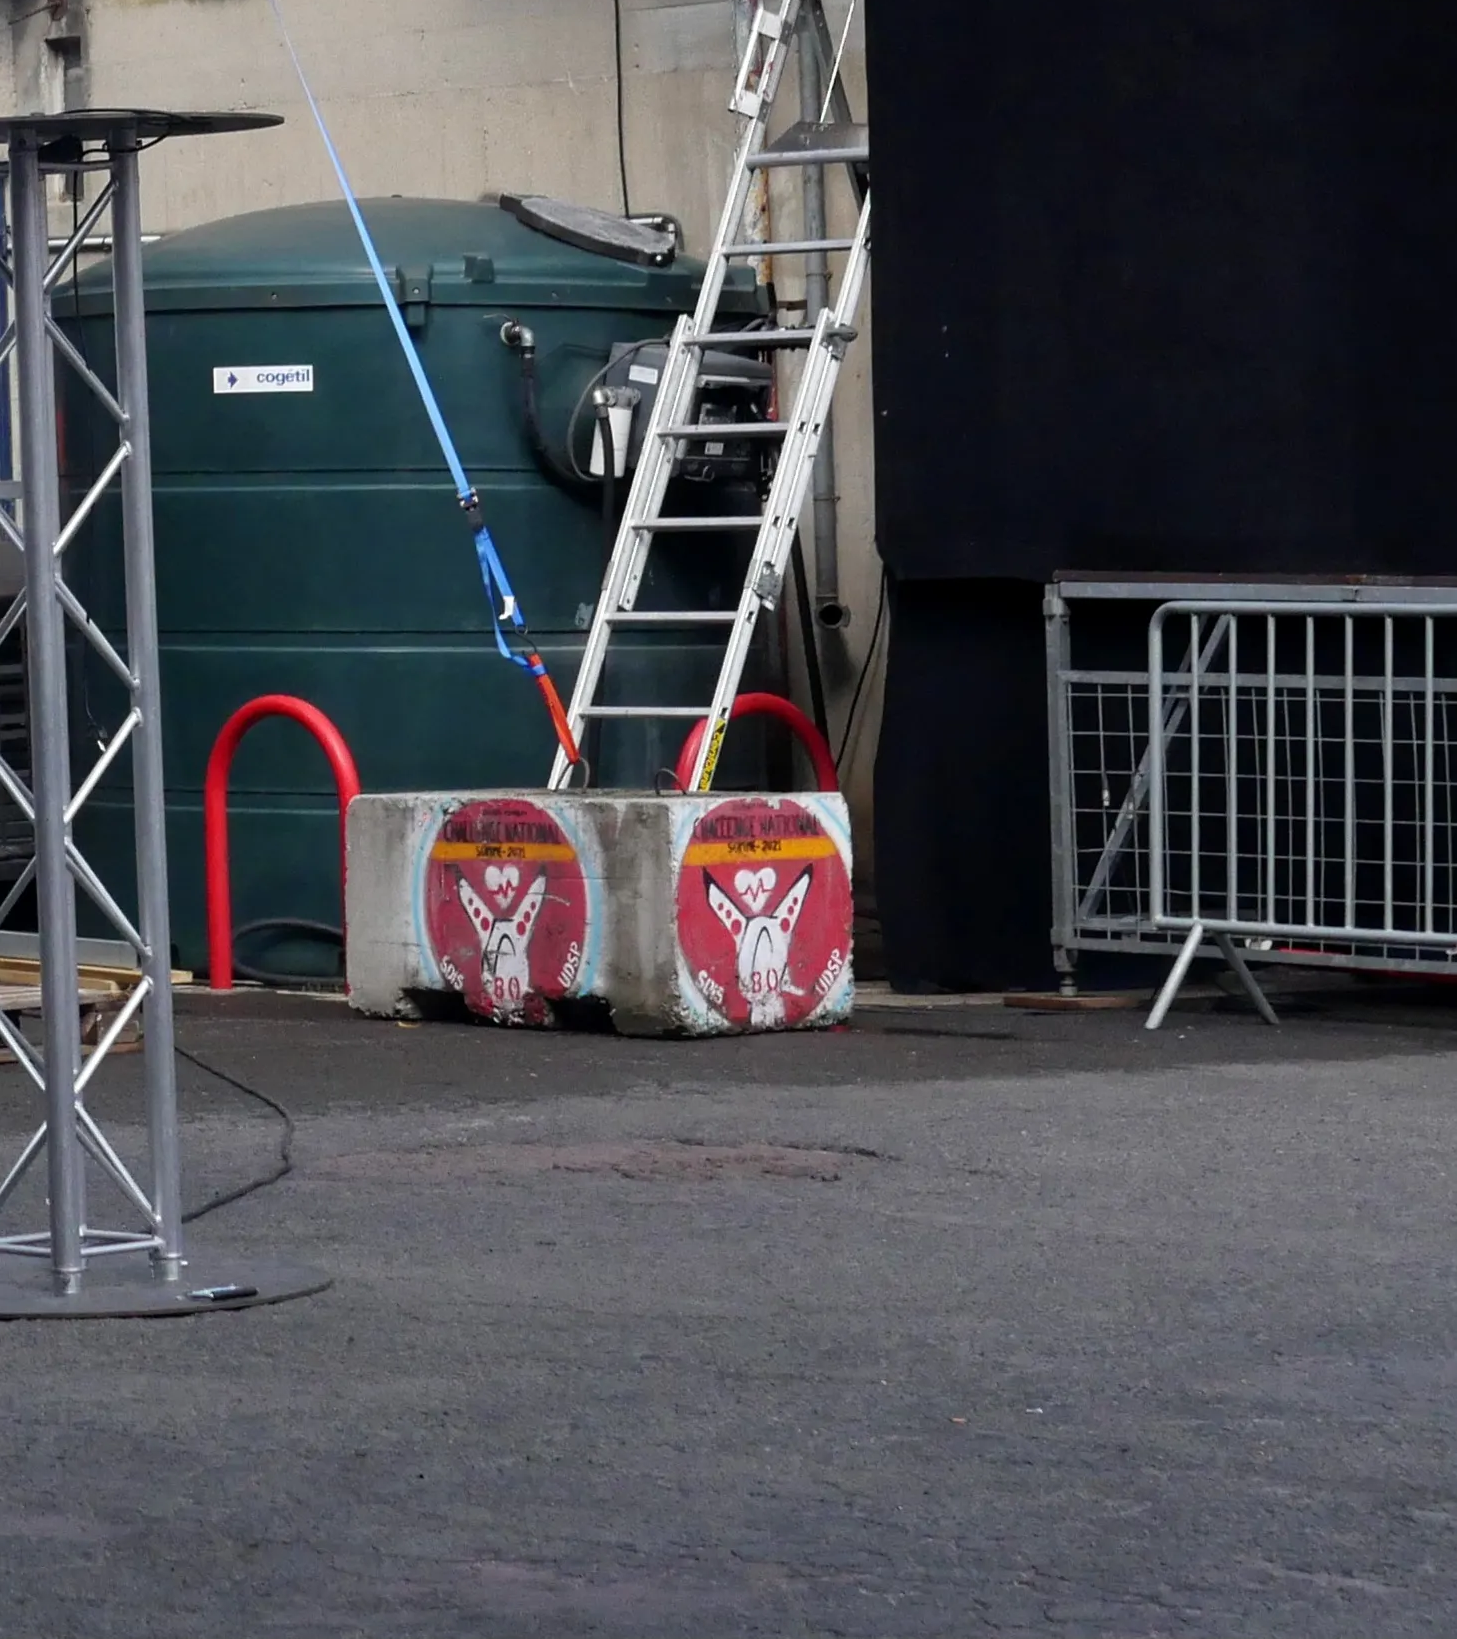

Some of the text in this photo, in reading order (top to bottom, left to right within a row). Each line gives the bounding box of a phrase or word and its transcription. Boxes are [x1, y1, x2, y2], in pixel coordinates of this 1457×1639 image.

[256, 368, 310, 386] cogétil
[439, 955, 465, 990] SDIS
[557, 941, 581, 989] UDSP
[815, 948, 843, 996] UDSP
[494, 976, 520, 1000] 80
[751, 968, 778, 993] 80
